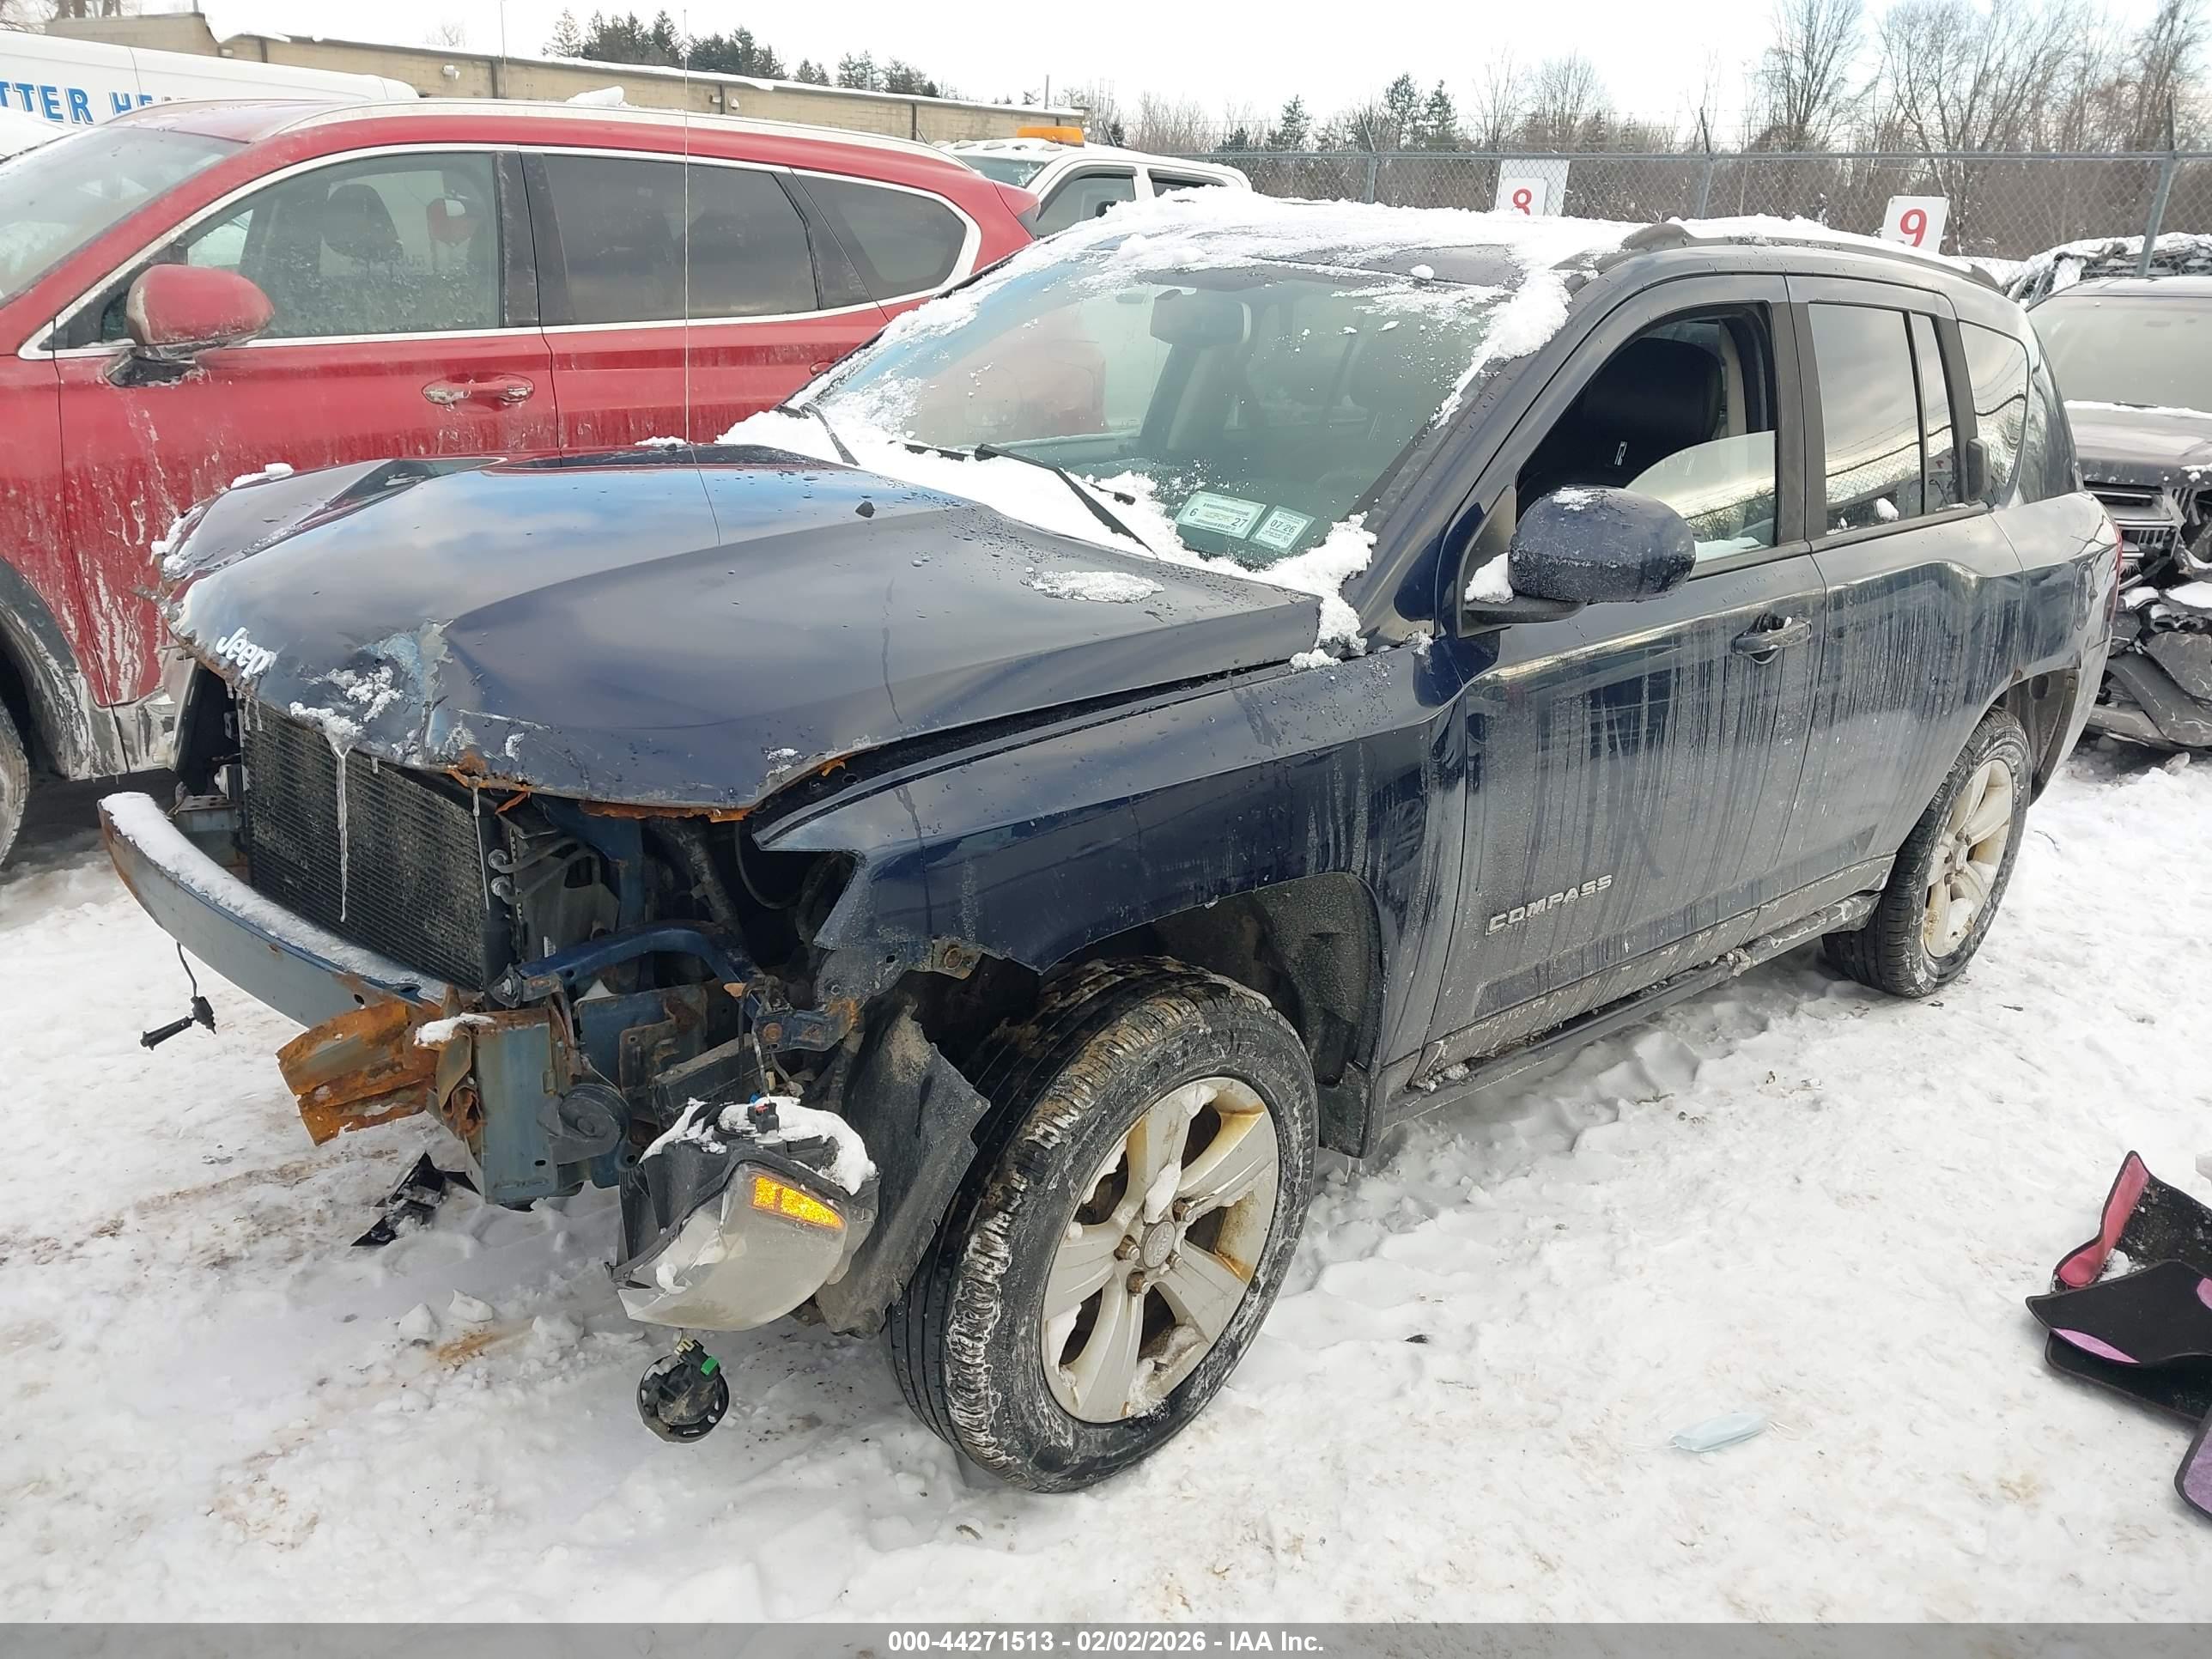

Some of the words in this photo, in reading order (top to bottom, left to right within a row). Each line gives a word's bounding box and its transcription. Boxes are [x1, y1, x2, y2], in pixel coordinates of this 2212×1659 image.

[1513, 188, 1532, 216] 8
[1900, 209, 1928, 247] 9
[1189, 507, 1199, 517] 6
[1231, 517, 1249, 528] 27
[1270, 519, 1284, 529] 07
[1283, 524, 1297, 533] 26
[216, 626, 277, 679] Jeep
[1486, 874, 1613, 934] COMPASS
